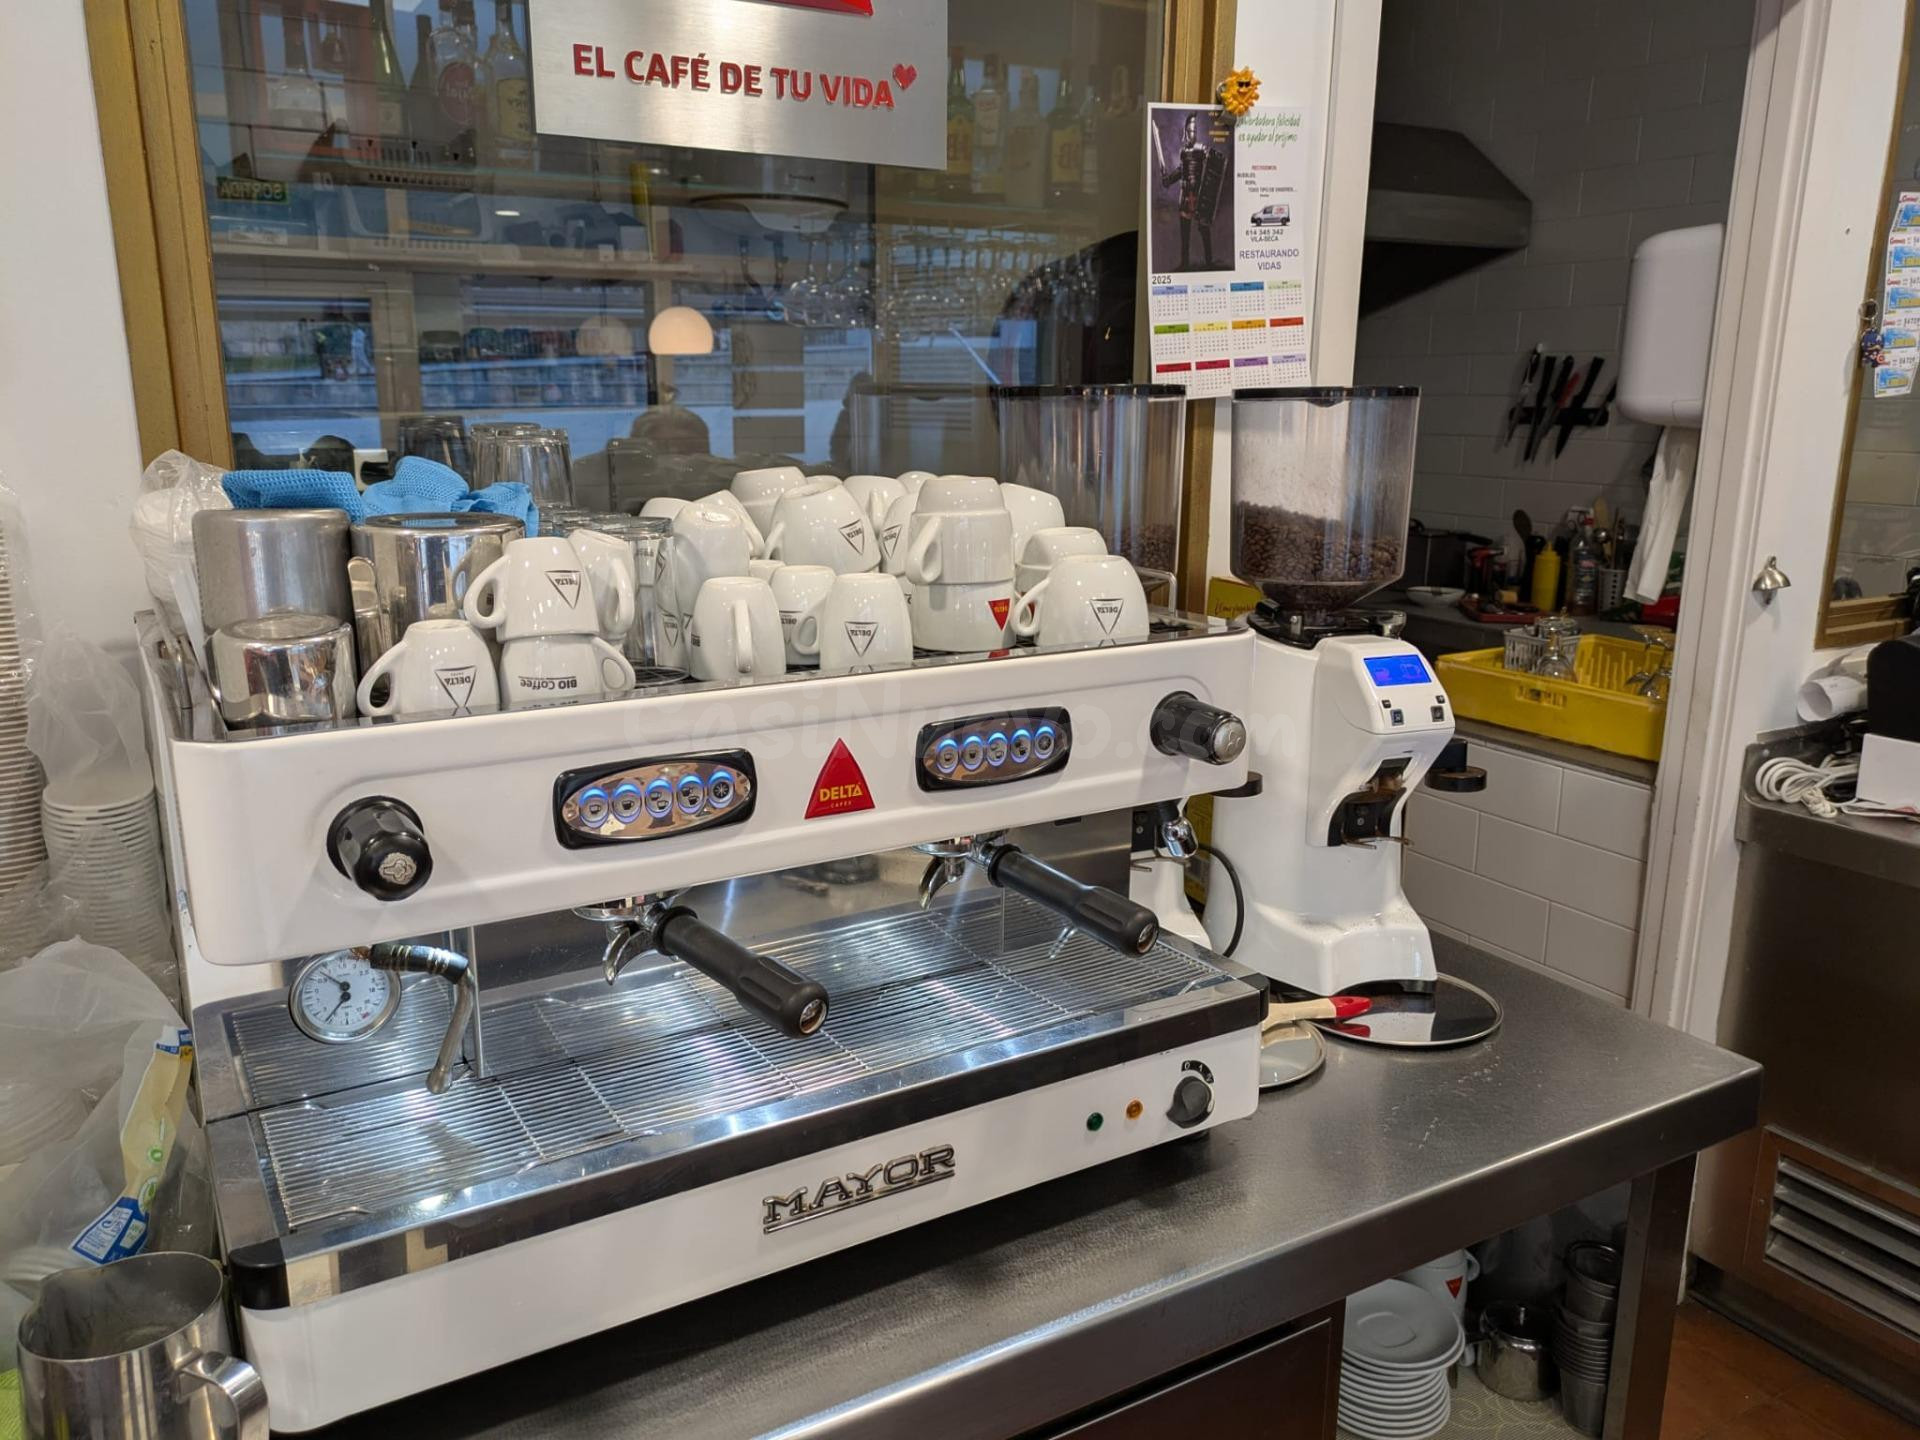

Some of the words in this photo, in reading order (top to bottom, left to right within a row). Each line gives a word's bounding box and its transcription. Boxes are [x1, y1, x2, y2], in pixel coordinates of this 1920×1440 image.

[573, 44, 615, 78] EL
[624, 51, 710, 90] CAFÉ
[720, 62, 762, 96] DE
[771, 67, 812, 101] TU
[820, 74, 895, 109] VIDA
[1240, 249, 1300, 260] RESTAURANDO
[1258, 262, 1282, 271] VIDAS
[1152, 275, 1172, 285] 2025
[1097, 606, 1119, 614] DELTA
[849, 629, 872, 637] DELTA
[443, 675, 471, 686] DELTA
[520, 677, 556, 690] Coffee
[557, 679, 577, 690] BIO
[819, 782, 864, 803] DELTA
[763, 1143, 956, 1226] MAYOR
